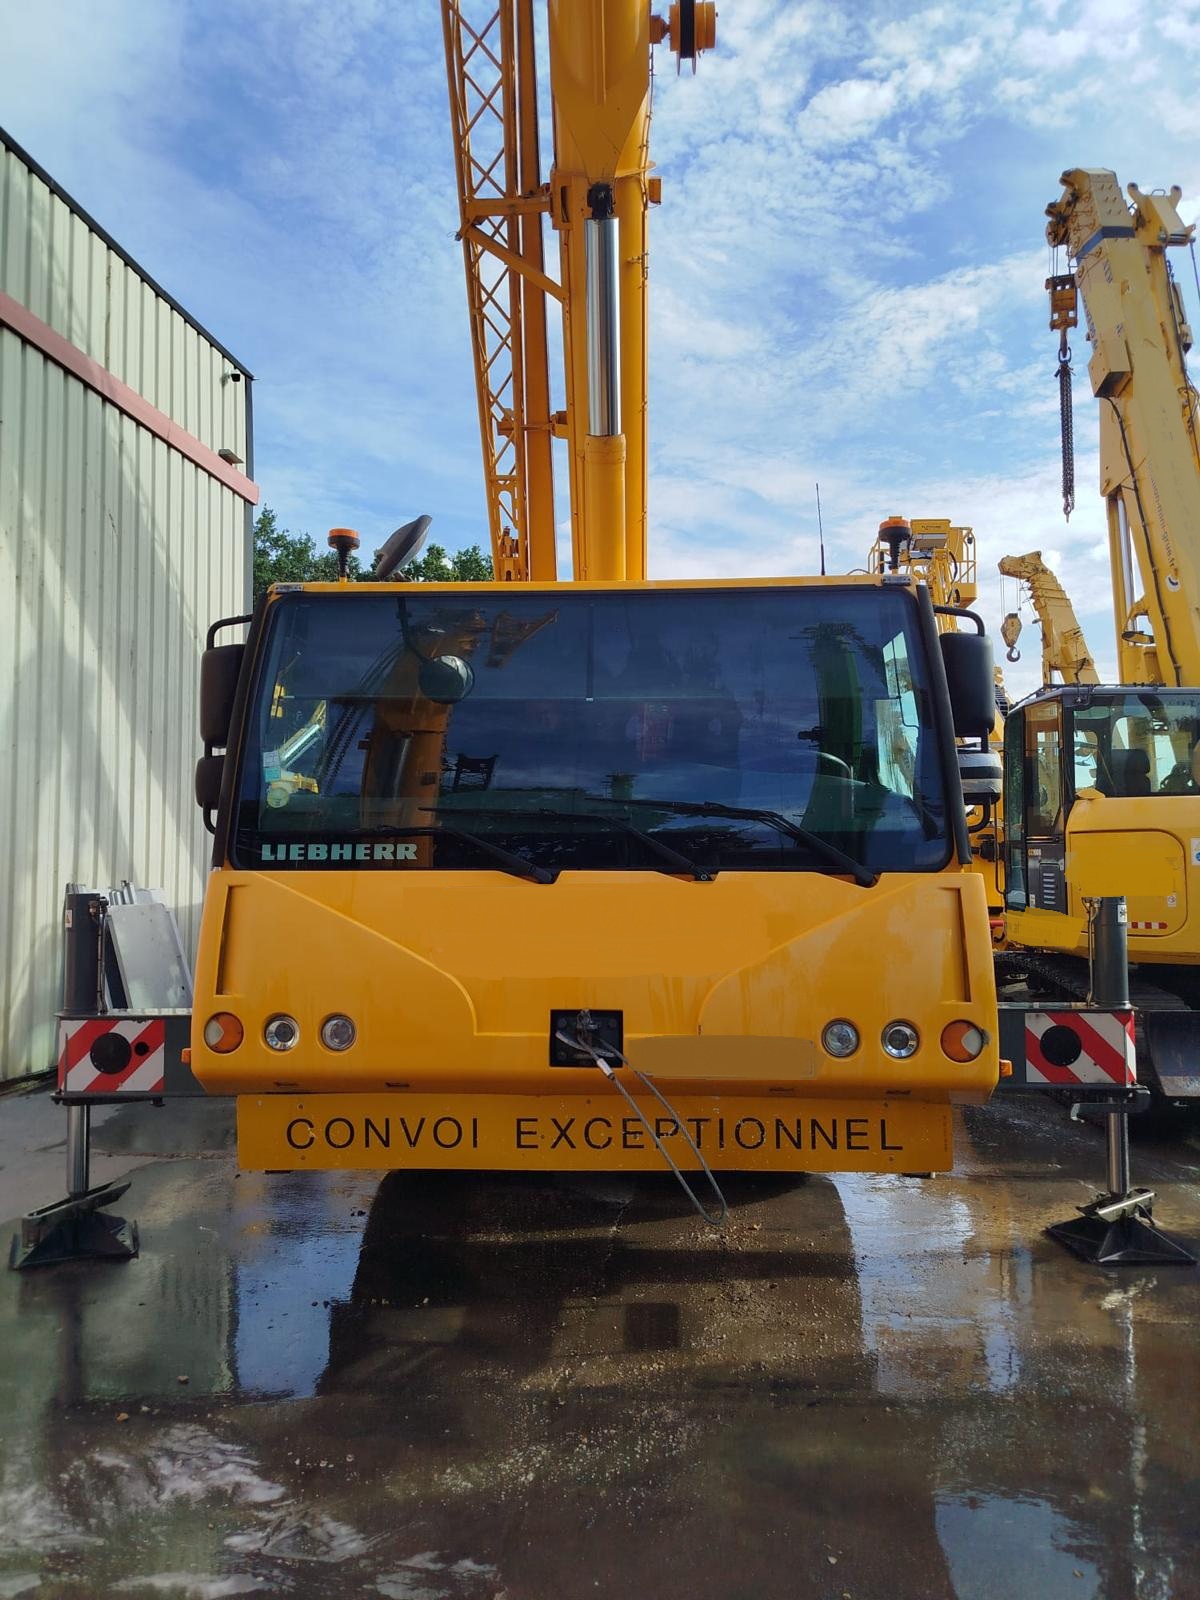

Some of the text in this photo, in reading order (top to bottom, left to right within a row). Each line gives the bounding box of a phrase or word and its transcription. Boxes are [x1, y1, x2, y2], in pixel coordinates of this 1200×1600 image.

[261, 843, 417, 861] LIEBHERR
[286, 1117, 903, 1151] CONVOI EXCEPTIONNEL
